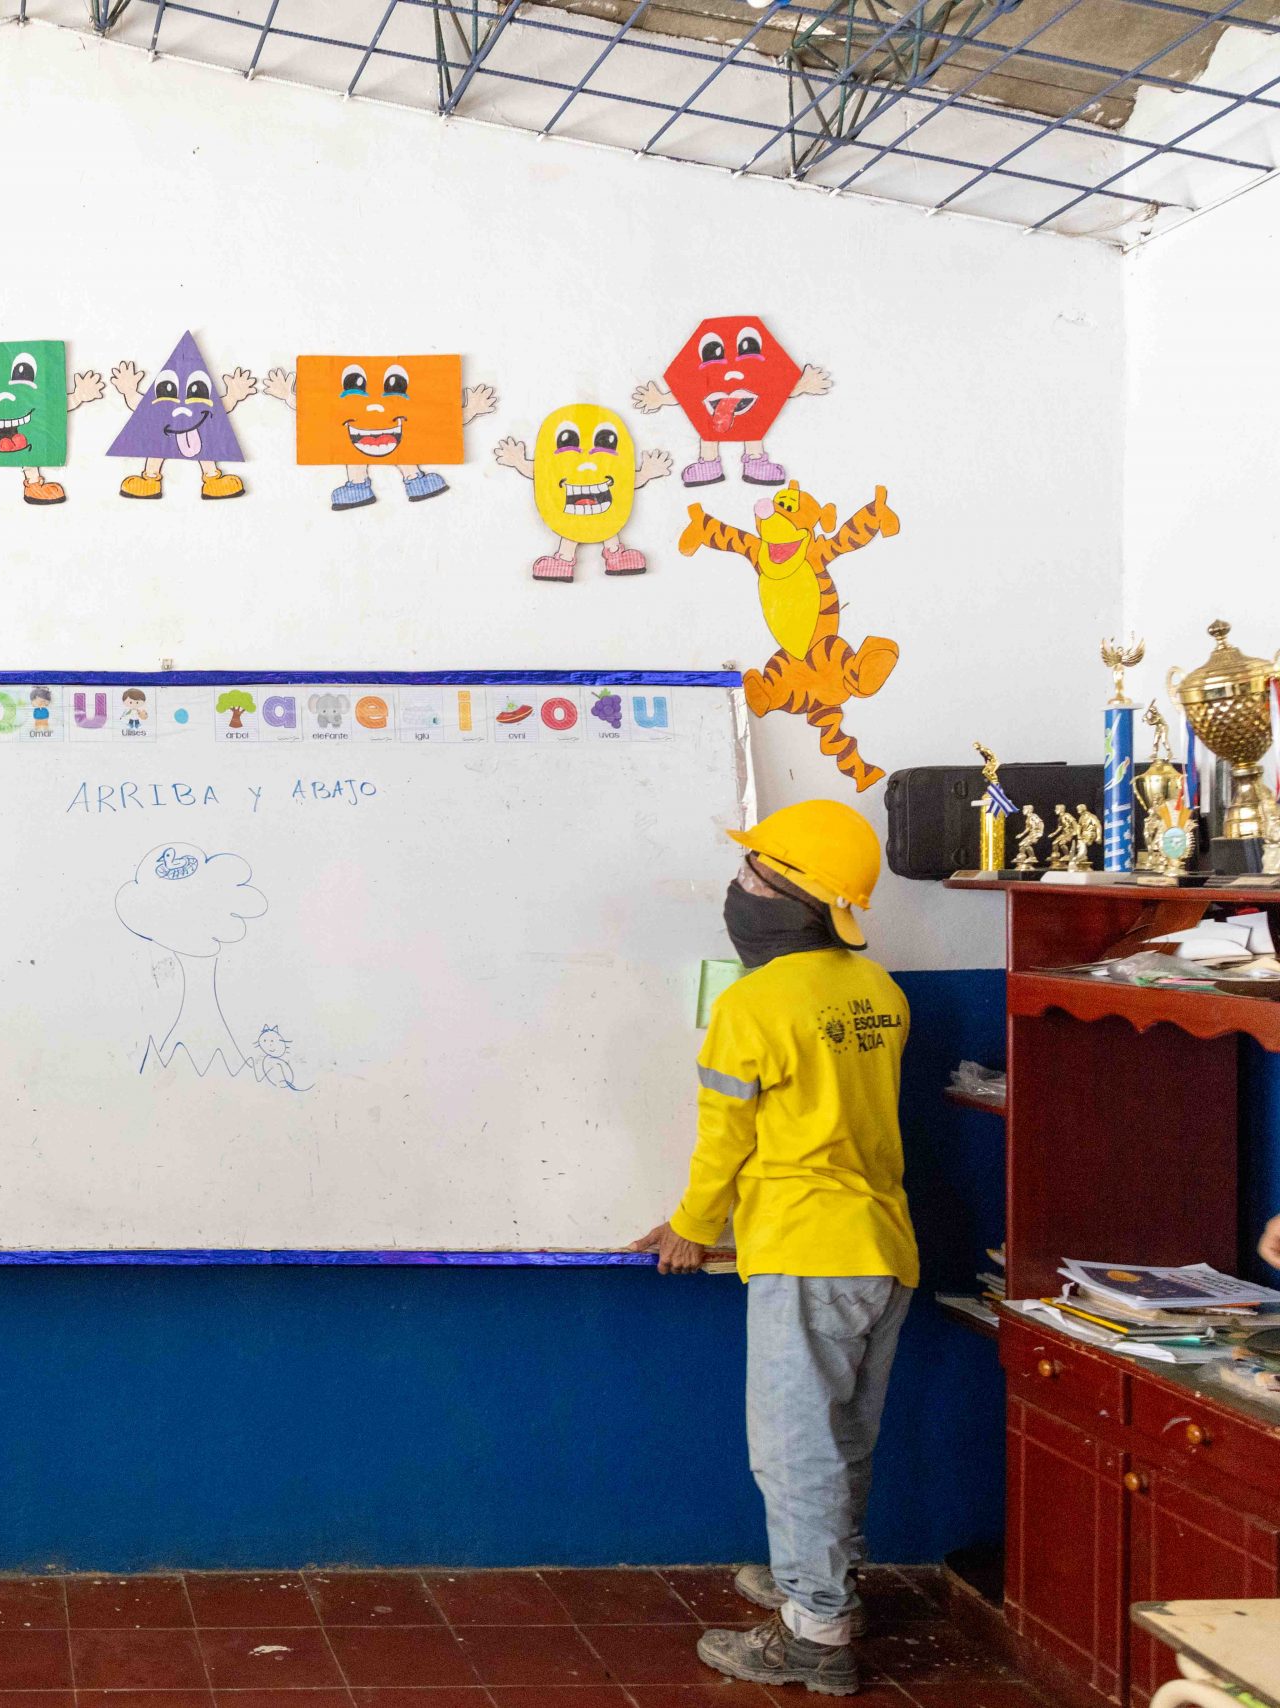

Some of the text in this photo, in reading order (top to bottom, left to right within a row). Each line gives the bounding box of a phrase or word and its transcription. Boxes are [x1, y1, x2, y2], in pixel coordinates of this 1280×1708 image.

[74, 692, 107, 729] U
[262, 690, 668, 731] a e i o u
[29, 729, 54, 738] Omar
[312, 731, 349, 740] elefante
[598, 731, 620, 739] uvas
[66, 781, 219, 813] ARRIBA
[292, 779, 377, 805] ABAJO
[847, 998, 874, 1015] UNA
[853, 1014, 902, 1031] ESCUELA
